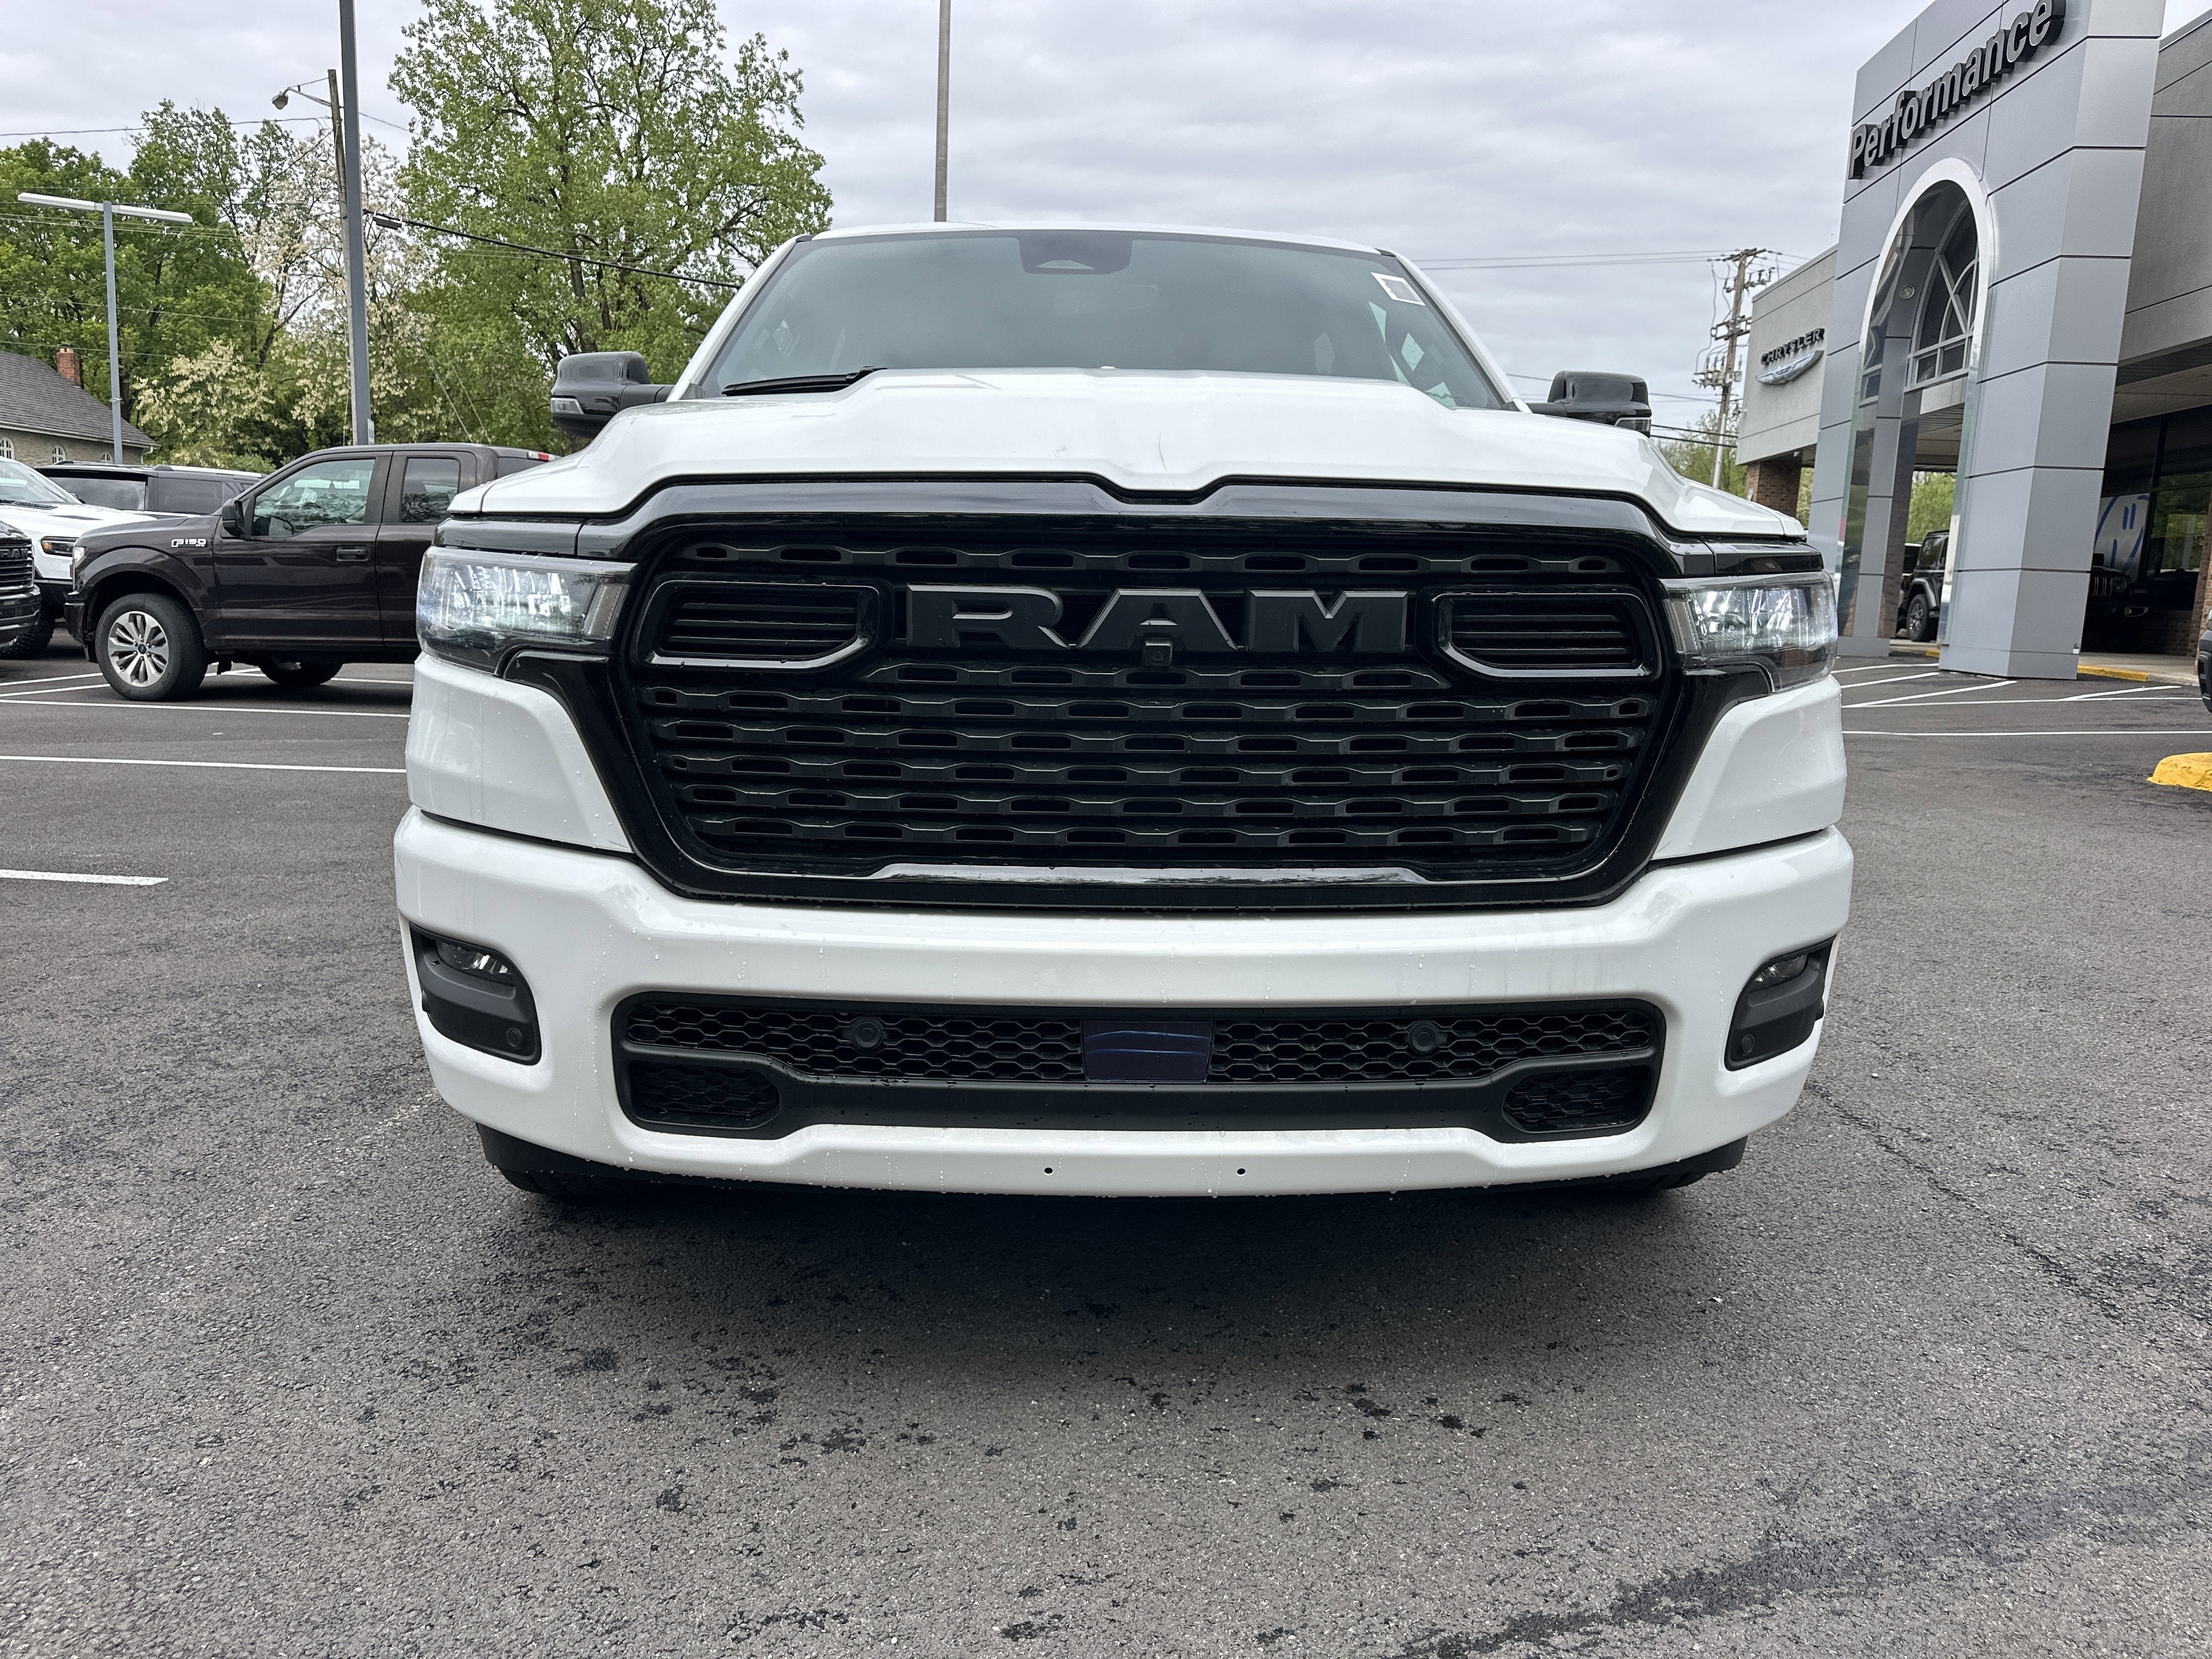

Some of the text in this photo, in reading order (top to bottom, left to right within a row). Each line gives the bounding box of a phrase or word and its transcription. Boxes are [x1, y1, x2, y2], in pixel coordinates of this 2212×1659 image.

[1848, 0, 2066, 179] Performance
[1760, 328, 1824, 365] CHRYSLER
[906, 584, 1408, 653] RAM
